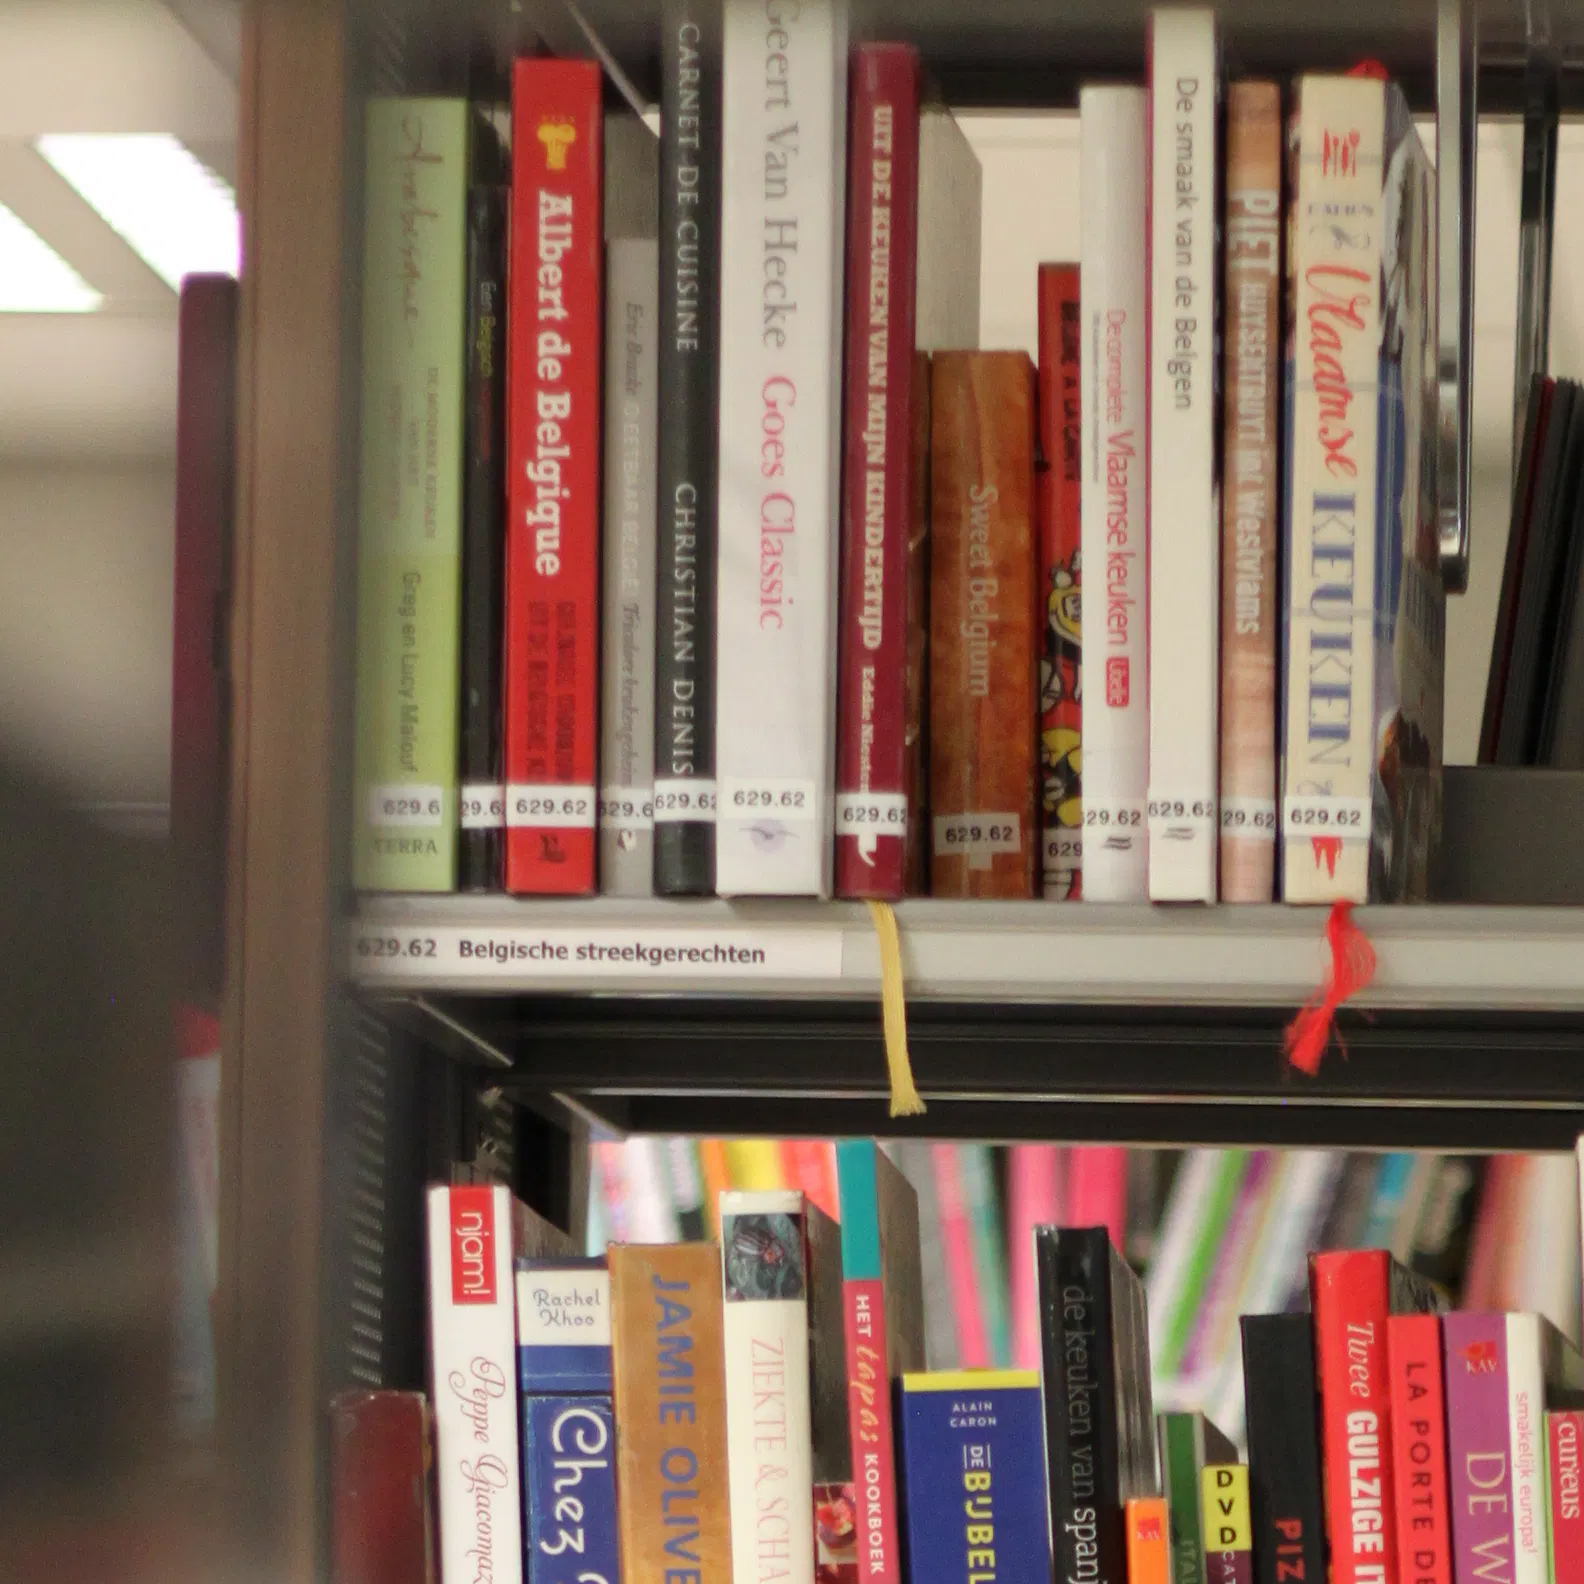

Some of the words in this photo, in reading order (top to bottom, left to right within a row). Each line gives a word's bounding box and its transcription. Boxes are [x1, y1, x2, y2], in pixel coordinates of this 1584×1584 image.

[1175, 77, 1199, 113] De
[677, 165, 698, 205] DE
[764, 121, 799, 201] Van
[1175, 121, 1199, 207] smaak
[537, 189, 574, 321] Albert
[677, 221, 698, 352] CUISINE
[763, 214, 798, 349] Hecke
[1175, 218, 1195, 266] van
[1175, 276, 1199, 308] de
[537, 331, 572, 390] de
[1166, 317, 1198, 410] Belgen
[761, 376, 797, 477] Goes
[526, 391, 571, 577] Belgique
[673, 483, 697, 662] CHRISTIAN
[758, 492, 796, 629] Classic
[1106, 551, 1137, 645] keuken
[959, 576, 999, 697] Belgium
[1307, 491, 1357, 767] KEUKEN
[671, 679, 694, 775] DENIS
[1291, 809, 1360, 826] 629.62
[459, 940, 569, 963] Belgische
[576, 942, 766, 967] streekgerechten
[454, 1210, 492, 1296] njam!
[652, 1273, 696, 1424] JAMIE
[1347, 1320, 1376, 1398] Twee
[1406, 1360, 1430, 1402] LA
[855, 1294, 872, 1339] HET
[864, 1454, 886, 1575] KOOKBOEK
[949, 1418, 997, 1428] CARON
[952, 1402, 993, 1414] ALAIN
[540, 1408, 607, 1556] Chez
[1345, 1410, 1384, 1554] GULZIGE
[1409, 1419, 1435, 1531] PORTE
[1466, 1452, 1508, 1515] DE
[1558, 1420, 1582, 1520] curieus
